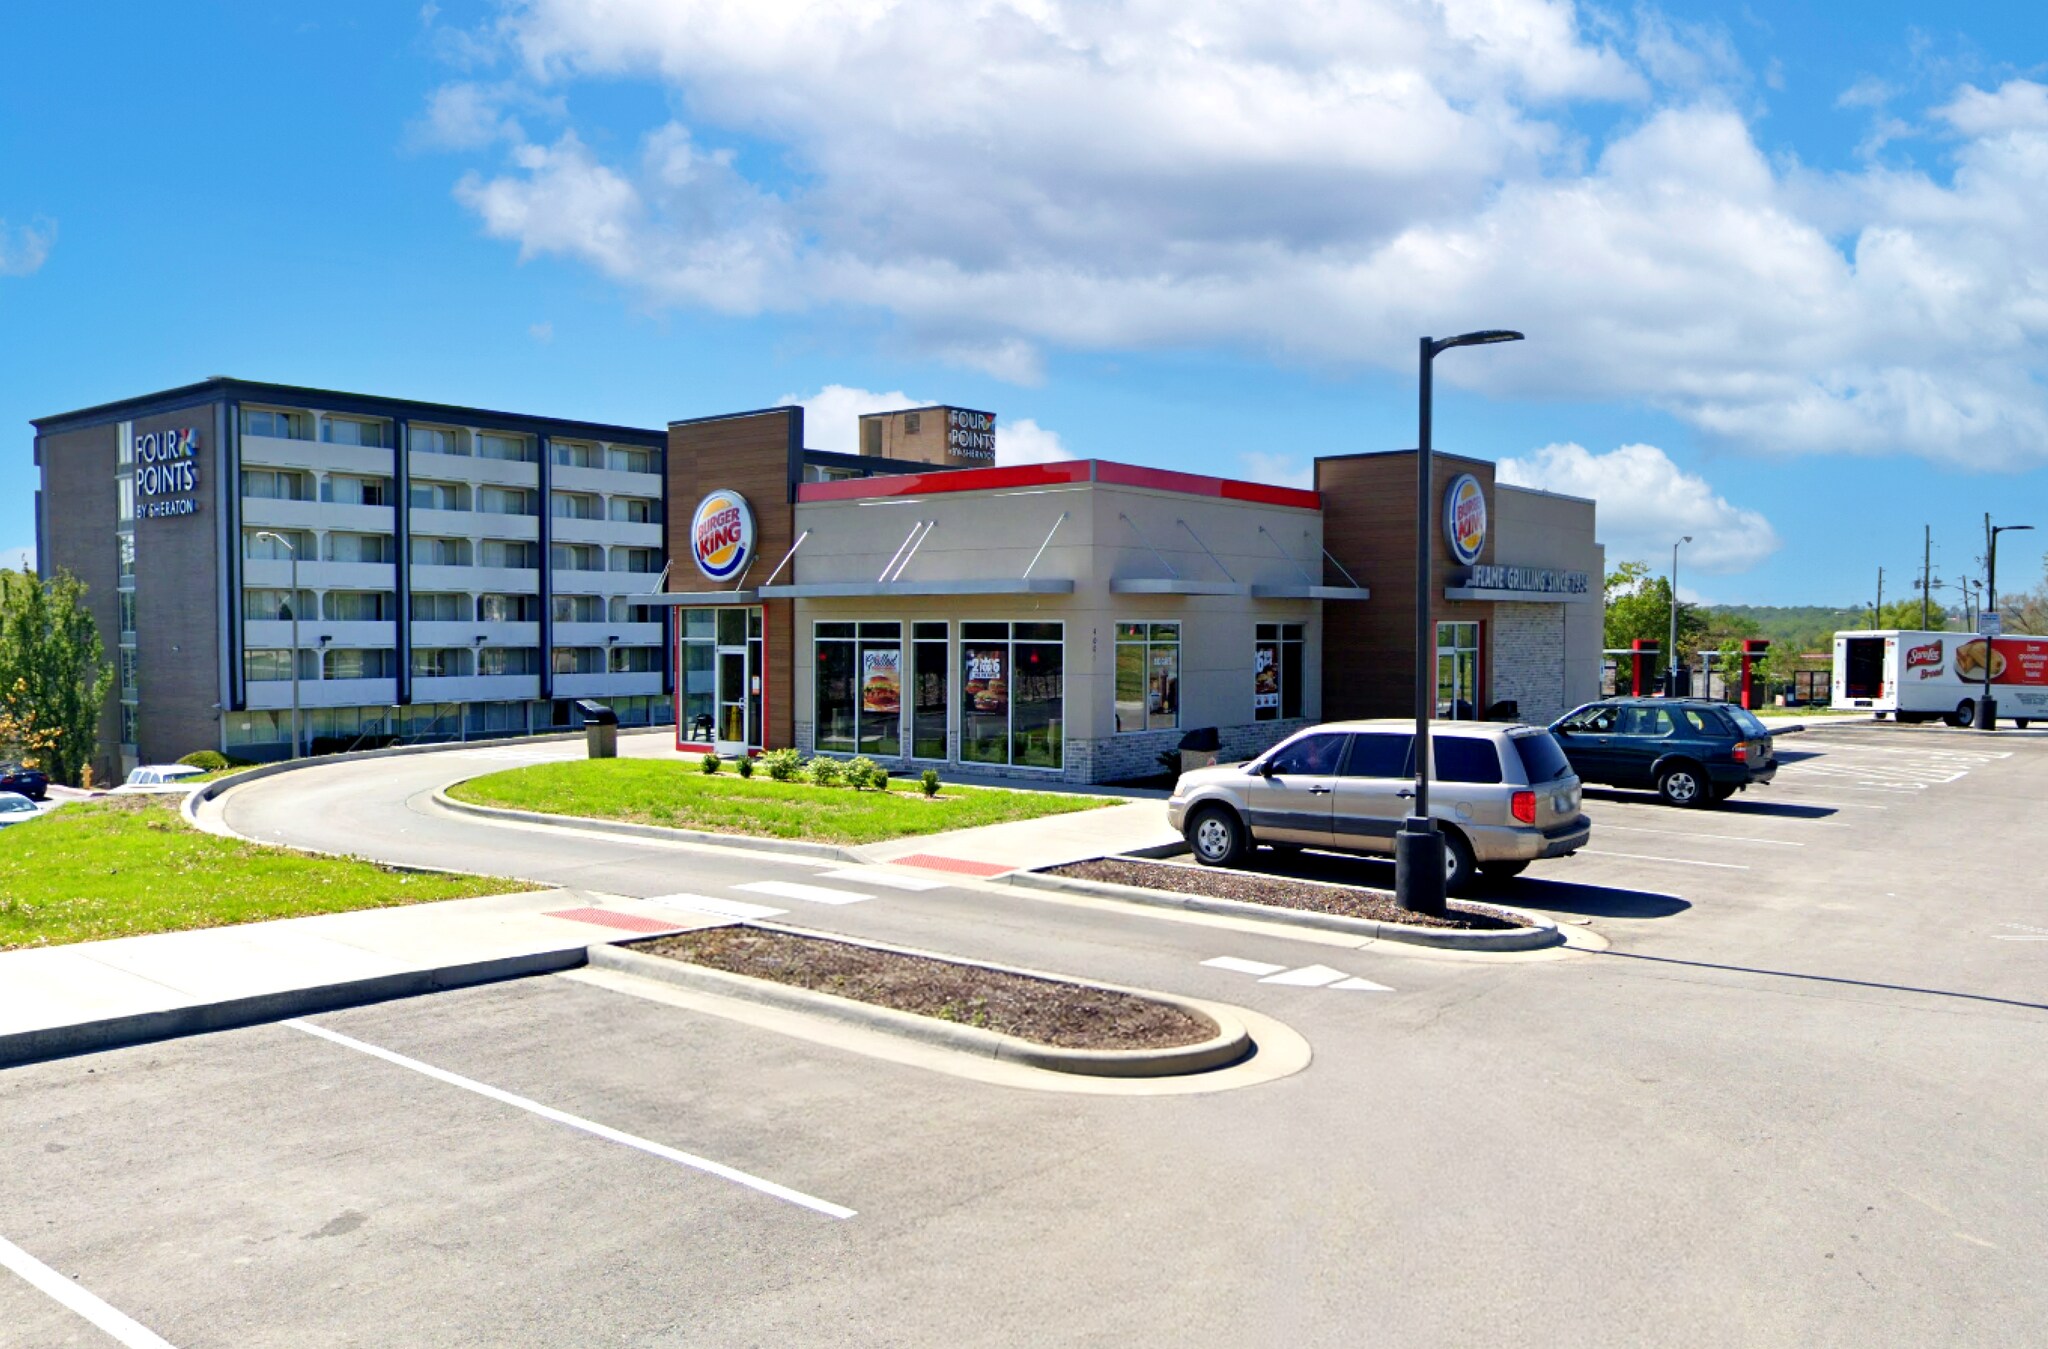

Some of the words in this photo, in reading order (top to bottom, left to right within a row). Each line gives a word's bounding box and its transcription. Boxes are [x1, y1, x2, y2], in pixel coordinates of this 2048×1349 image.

[951, 409, 986, 430] FOUR
[136, 430, 178, 463] FOUR
[952, 429, 995, 450] POINTS
[136, 460, 194, 496] POINTS
[136, 504, 147, 519] BY
[698, 508, 740, 540] BURGER
[1457, 511, 1483, 541] KIN
[699, 521, 741, 561] KING
[1474, 565, 1504, 588] FLAME
[1507, 567, 1545, 591] GRILLING
[971, 658, 979, 672] 2
